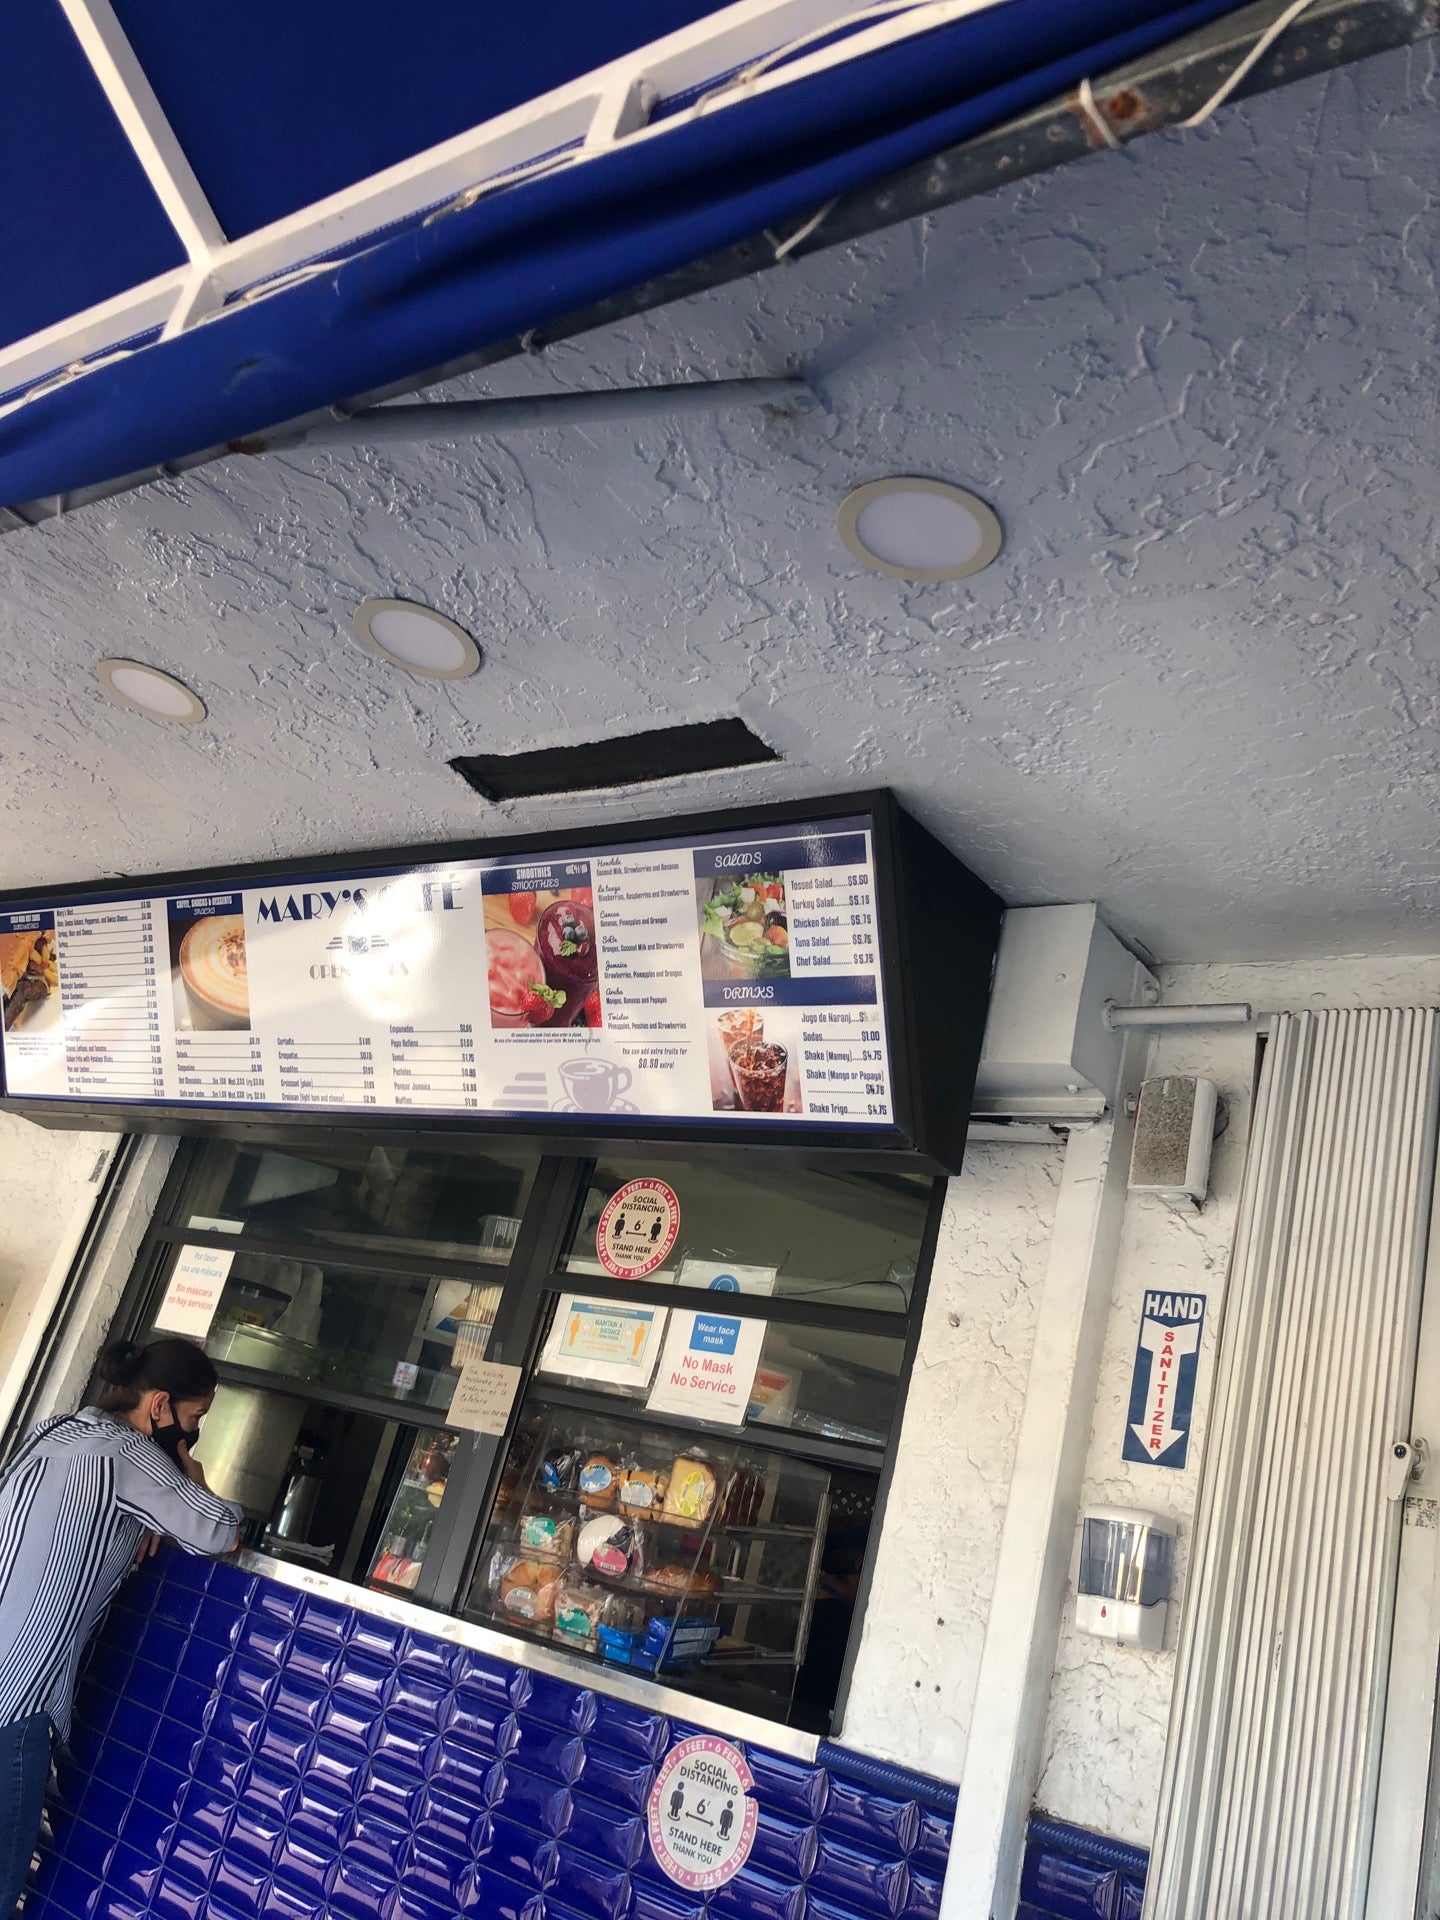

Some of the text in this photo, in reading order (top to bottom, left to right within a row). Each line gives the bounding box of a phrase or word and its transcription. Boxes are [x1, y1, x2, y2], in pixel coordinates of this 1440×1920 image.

[714, 851, 762, 868] SALADS
[516, 866, 552, 880] SMOOTHIES
[652, 864, 660, 872] and
[511, 878, 560, 891] SMOOTHIES
[790, 874, 869, 890] Tossed Salad $5.50
[652, 890, 660, 898] and
[257, 888, 368, 924] MARY'S
[792, 898, 815, 910] Turkey
[816, 897, 835, 908] Salad
[642, 917, 650, 925] and
[794, 914, 872, 928] Chicken Salad $5.75
[648, 943, 656, 951] and
[795, 934, 872, 948] Tuna Salad $5.75
[796, 954, 874, 966] Chef Salad $5.75
[656, 970, 664, 978] and
[722, 985, 775, 1000] DRINKS
[642, 996, 650, 1004] and
[801, 1012, 818, 1024] Jugo
[818, 1012, 828, 1023] de
[649, 1022, 657, 1030] and
[802, 1030, 880, 1042] Sodas $1.00
[640, 1047, 650, 1055] add
[650, 1047, 664, 1055] extra
[664, 1047, 679, 1055] fruits
[680, 1047, 688, 1055] for
[804, 1050, 824, 1061] Shake
[826, 1050, 853, 1062] (Mamey)
[638, 1057, 660, 1070] $0.50
[806, 1069, 885, 1082] Shake (Mango or Papaya)
[809, 1102, 830, 1114] Shake
[830, 1103, 849, 1116] Trigo
[632, 1196, 658, 1205] SOCIAL
[621, 1202, 666, 1214] DISTANCING
[612, 1242, 653, 1255] STAND HERE
[614, 1252, 645, 1262] THANK YOU
[175, 1283, 186, 1292] Sin
[176, 1296, 186, 1308] hay
[188, 1300, 213, 1311] servicio
[1144, 1293, 1204, 1320] HAND
[697, 1322, 736, 1336] Wear face
[702, 1335, 724, 1346] mask
[682, 1355, 734, 1376] No Mask
[670, 1372, 736, 1394] No Service
[1149, 1331, 1175, 1450] SANITIZER
[679, 1740, 706, 1758] 6 FEET
[714, 1743, 742, 1770] 6 FEET
[694, 1759, 728, 1780] SOCIAL
[654, 1760, 674, 1796] 6 FEET
[680, 1766, 739, 1796] DISTANCING
[650, 1806, 662, 1844] 6 FEET
[668, 1826, 723, 1857] STAND HERE
[672, 1842, 713, 1866] THANK YOU
[730, 1830, 750, 1868] 6 FEET
